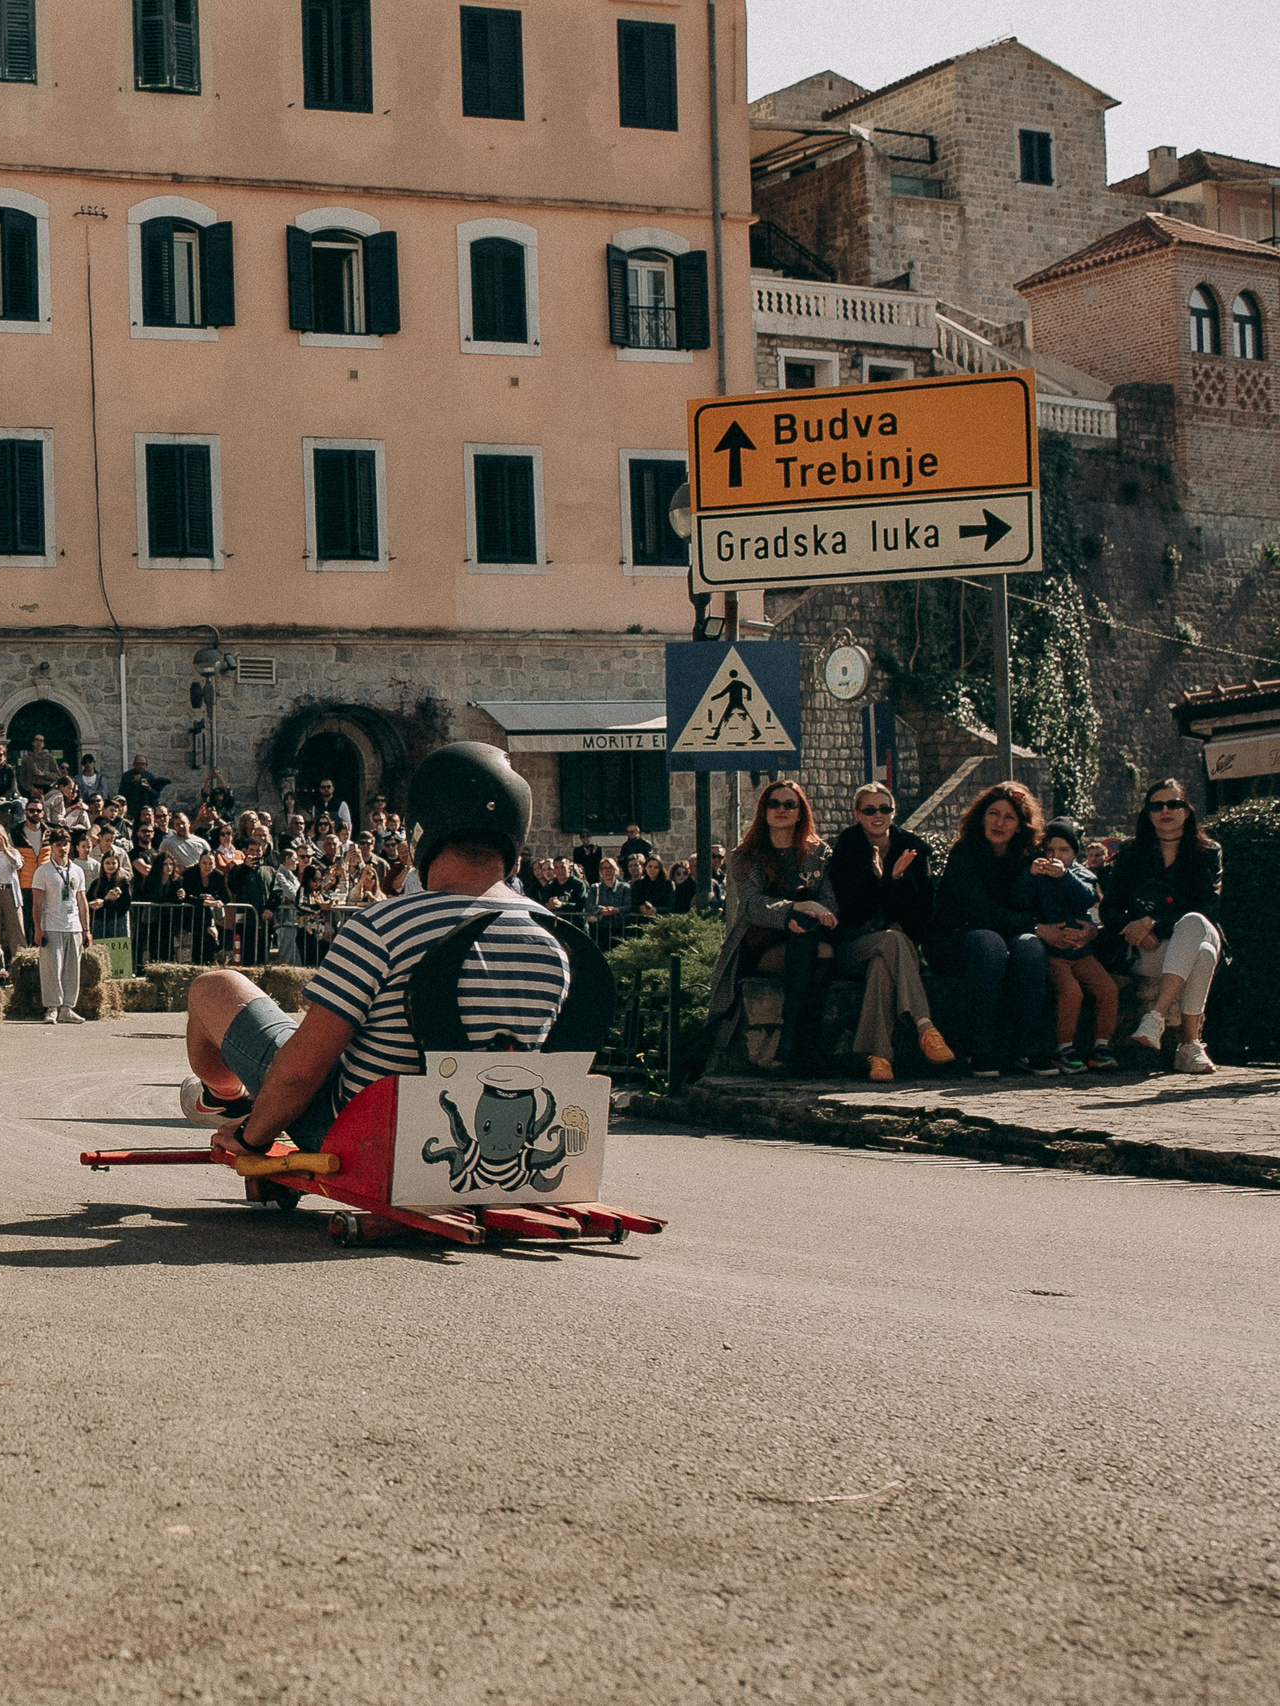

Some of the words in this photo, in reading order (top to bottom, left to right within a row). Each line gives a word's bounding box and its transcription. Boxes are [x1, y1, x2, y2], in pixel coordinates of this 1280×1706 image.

[774, 408, 898, 446] Budva
[775, 447, 939, 488] Trebinje
[716, 524, 847, 562] Gradska
[872, 518, 940, 552] luka
[582, 735, 644, 749] MORITZ
